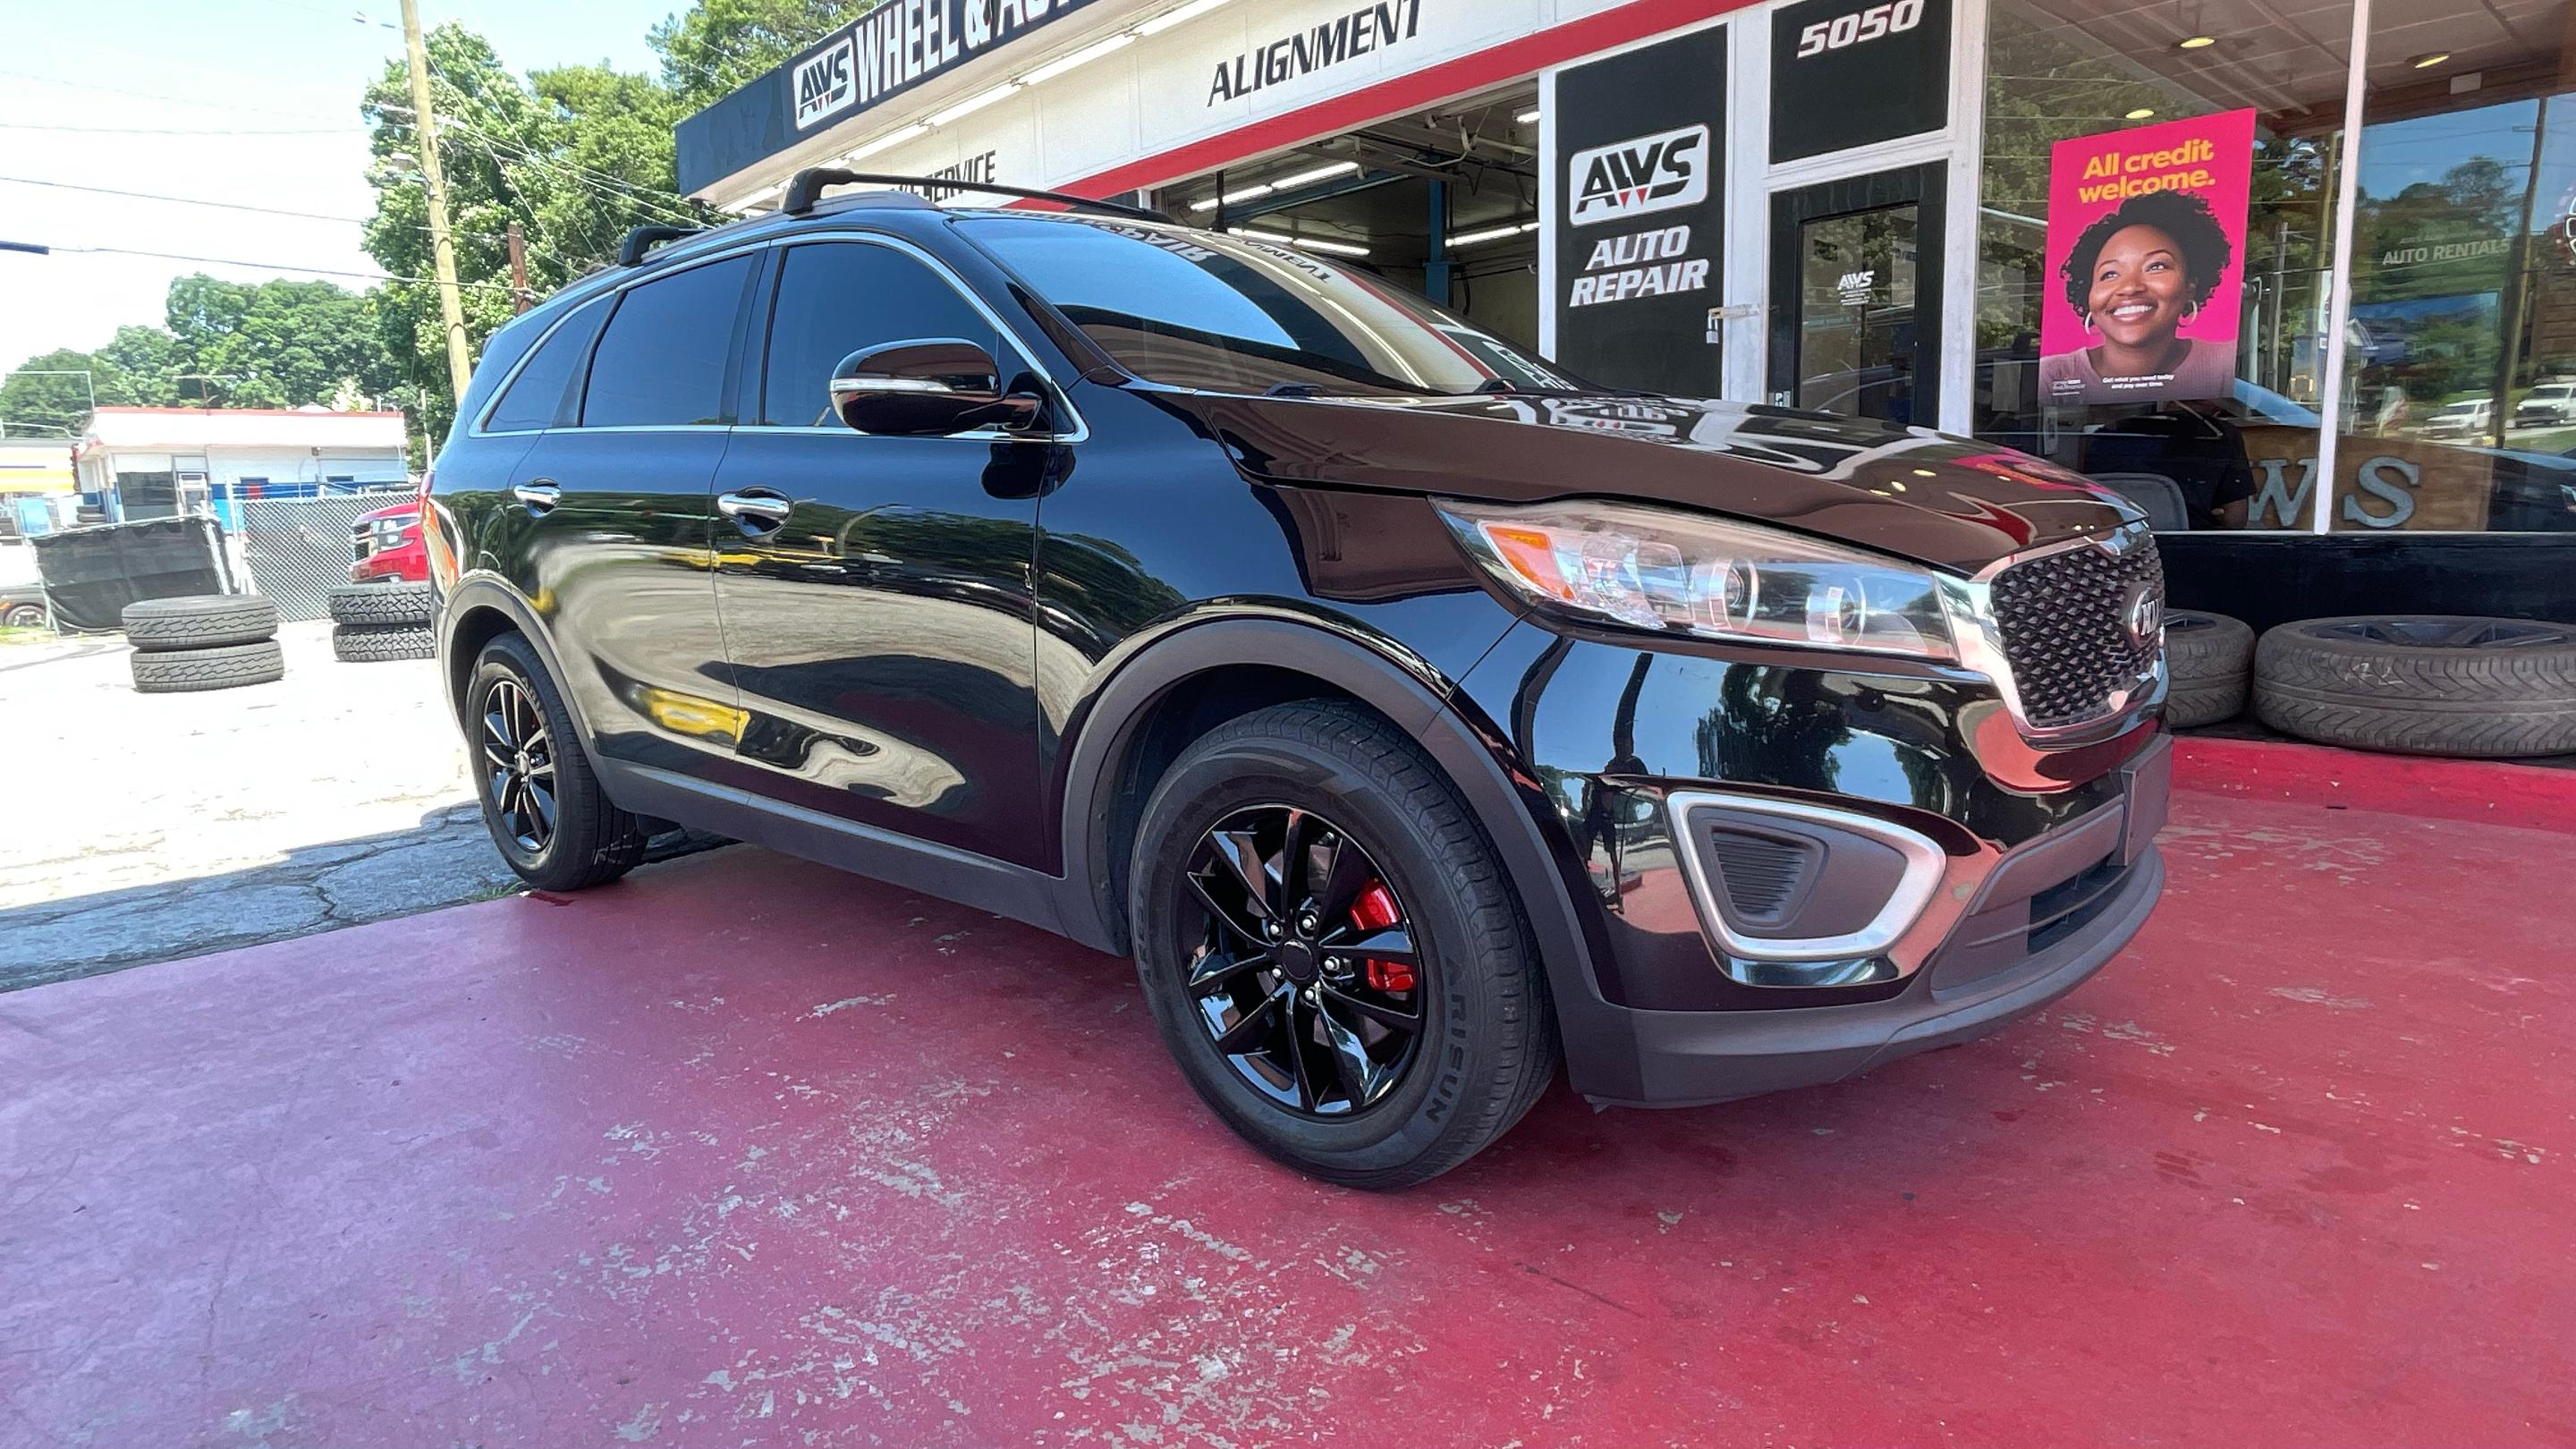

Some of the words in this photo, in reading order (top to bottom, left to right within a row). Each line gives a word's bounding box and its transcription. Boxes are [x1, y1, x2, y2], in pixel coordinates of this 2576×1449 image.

[1207, 0, 1420, 107] ALIGNMENT
[1797, 0, 1923, 59] 5050
[799, 43, 850, 119] AWS
[855, 0, 959, 104] WHEEL
[1575, 132, 1702, 215] AWS
[2082, 152, 2119, 180] All
[2124, 139, 2215, 172] credit
[2078, 168, 2216, 204] welcome.
[1585, 225, 1690, 270] AUTO
[2382, 247, 2428, 266] AUTO
[2432, 238, 2511, 260] RENTALS
[1569, 258, 1709, 308] REPAIR
[1837, 270, 1875, 291] AWS
[1425, 955, 1467, 1123] ARISUN
